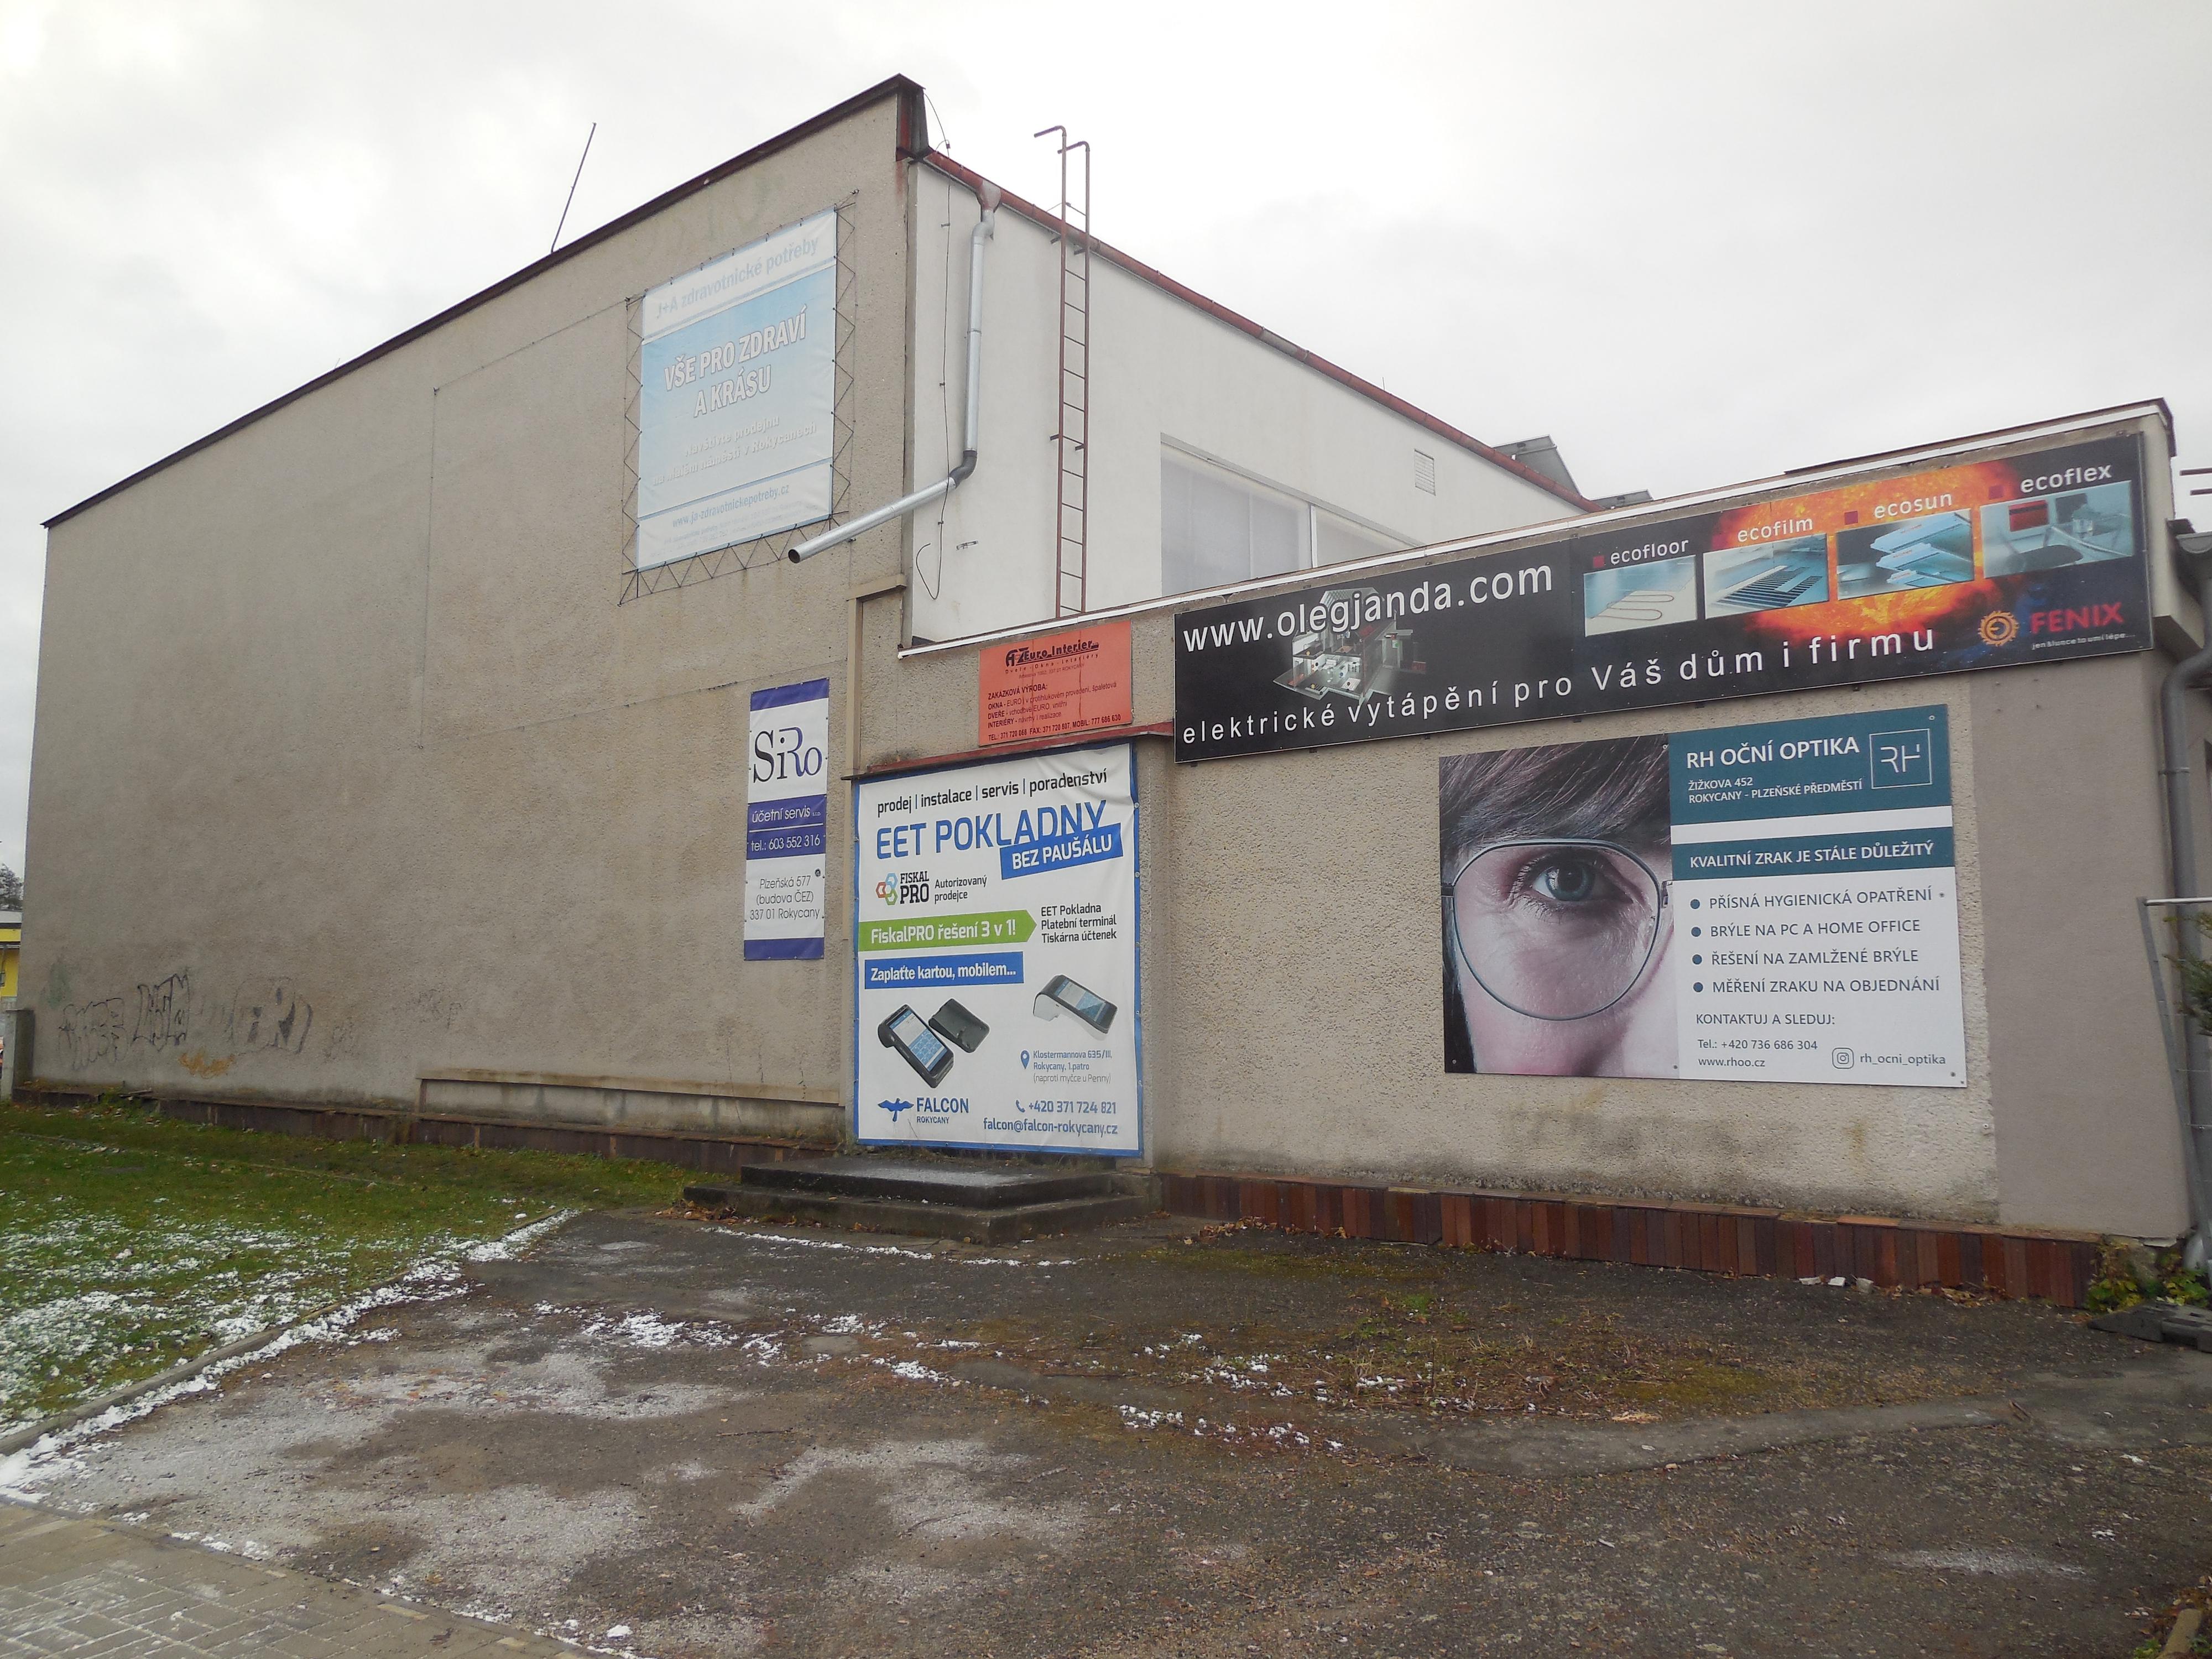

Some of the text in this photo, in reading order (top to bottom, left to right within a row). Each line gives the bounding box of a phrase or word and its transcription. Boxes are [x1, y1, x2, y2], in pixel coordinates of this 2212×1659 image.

[682, 258, 761, 307] zdravotnické
[766, 237, 818, 274] potřeby
[664, 304, 806, 392] VŠE PRO ZDRAVÍ
[693, 364, 771, 418] A KRÁSU
[2020, 463, 2112, 493] ecoflex
[1874, 492, 1953, 519] ecosun
[1738, 517, 1813, 542] ecofilm
[1610, 539, 1689, 565] ecofloor
[1183, 564, 1553, 653] www.olegjanda.com
[2031, 602, 2125, 634] FENIX
[1183, 629, 1934, 744] elektrické vytápění pro Váš dům i firmu
[988, 702, 1003, 710] OKNA
[1034, 703, 1050, 711] EURO
[753, 726, 823, 784] SiRo
[1687, 736, 1860, 769] RH OČNÍ OPTIKA
[878, 769, 1108, 817] prodej instalace servis poradenství
[1688, 777, 1753, 791] ŽIŽKOVA 452
[1688, 778, 1863, 804] ROKYCANY PLZEŇSKÉ PŘEDMĚSTÍ
[752, 807, 784, 823] účetní
[785, 805, 811, 820] servis
[877, 799, 1107, 860] EET POKLADNY
[751, 834, 820, 852] tel.: 603 552 316
[1012, 833, 1112, 870] BEZ PAUŠÁLU
[1690, 839, 1934, 869] KVALITNÍ ZRAK JE STÁLE DŮLEŽITÝ
[760, 875, 811, 889] Plzeňská 577
[900, 871, 930, 884] FISKAL
[935, 874, 987, 889] Autorizovaný
[756, 890, 814, 906] (budova ČEZ)
[900, 883, 930, 904] PRO
[935, 890, 968, 904] prodejce
[1709, 885, 1933, 910] PŘÍSNÁ HYGIENICKÁ OPATŘENÍ
[750, 907, 820, 921] 337 01 Rokycany
[1041, 902, 1102, 917] EET Pokladna
[871, 919, 1016, 943] FiskalPRO řešení 3 v 1!
[1041, 914, 1117, 930] Platební terminál
[1710, 919, 1921, 937] BRÝLE NA PC A HOME OFFICE
[1042, 928, 1117, 943] Tiskárna účtenek
[1712, 946, 1919, 966] ŘEŠENÍ NA ZAMLŽENÉ BRÝLE
[870, 963, 1016, 983] Zaplaťte kartou, mobilem...
[1712, 975, 1940, 993] MĚŘENÍ ZRAKU NA OBJEDNÁNÍ
[1696, 1014, 1835, 1027] KONTAKTUJ A SLEDUJ:
[1697, 1039, 1818, 1050] Tel.: +420 736 686 304
[1033, 1050, 1086, 1058] Klostermannova
[1698, 1056, 1766, 1068] www.rhoo.cz
[1860, 1053, 1947, 1067] rh_ocni_optika
[1033, 1062, 1067, 1073] Rokycany,
[1034, 1073, 1058, 1084] (naproti
[1060, 1073, 1081, 1084] myčce
[1088, 1073, 1111, 1084] Penny)
[916, 1097, 969, 1113] FALCON
[1029, 1100, 1117, 1114] +420 371 724 821
[916, 1115, 950, 1124] ROKYCANY
[983, 1117, 1118, 1138] falcon@falcon-rokycany.cz
